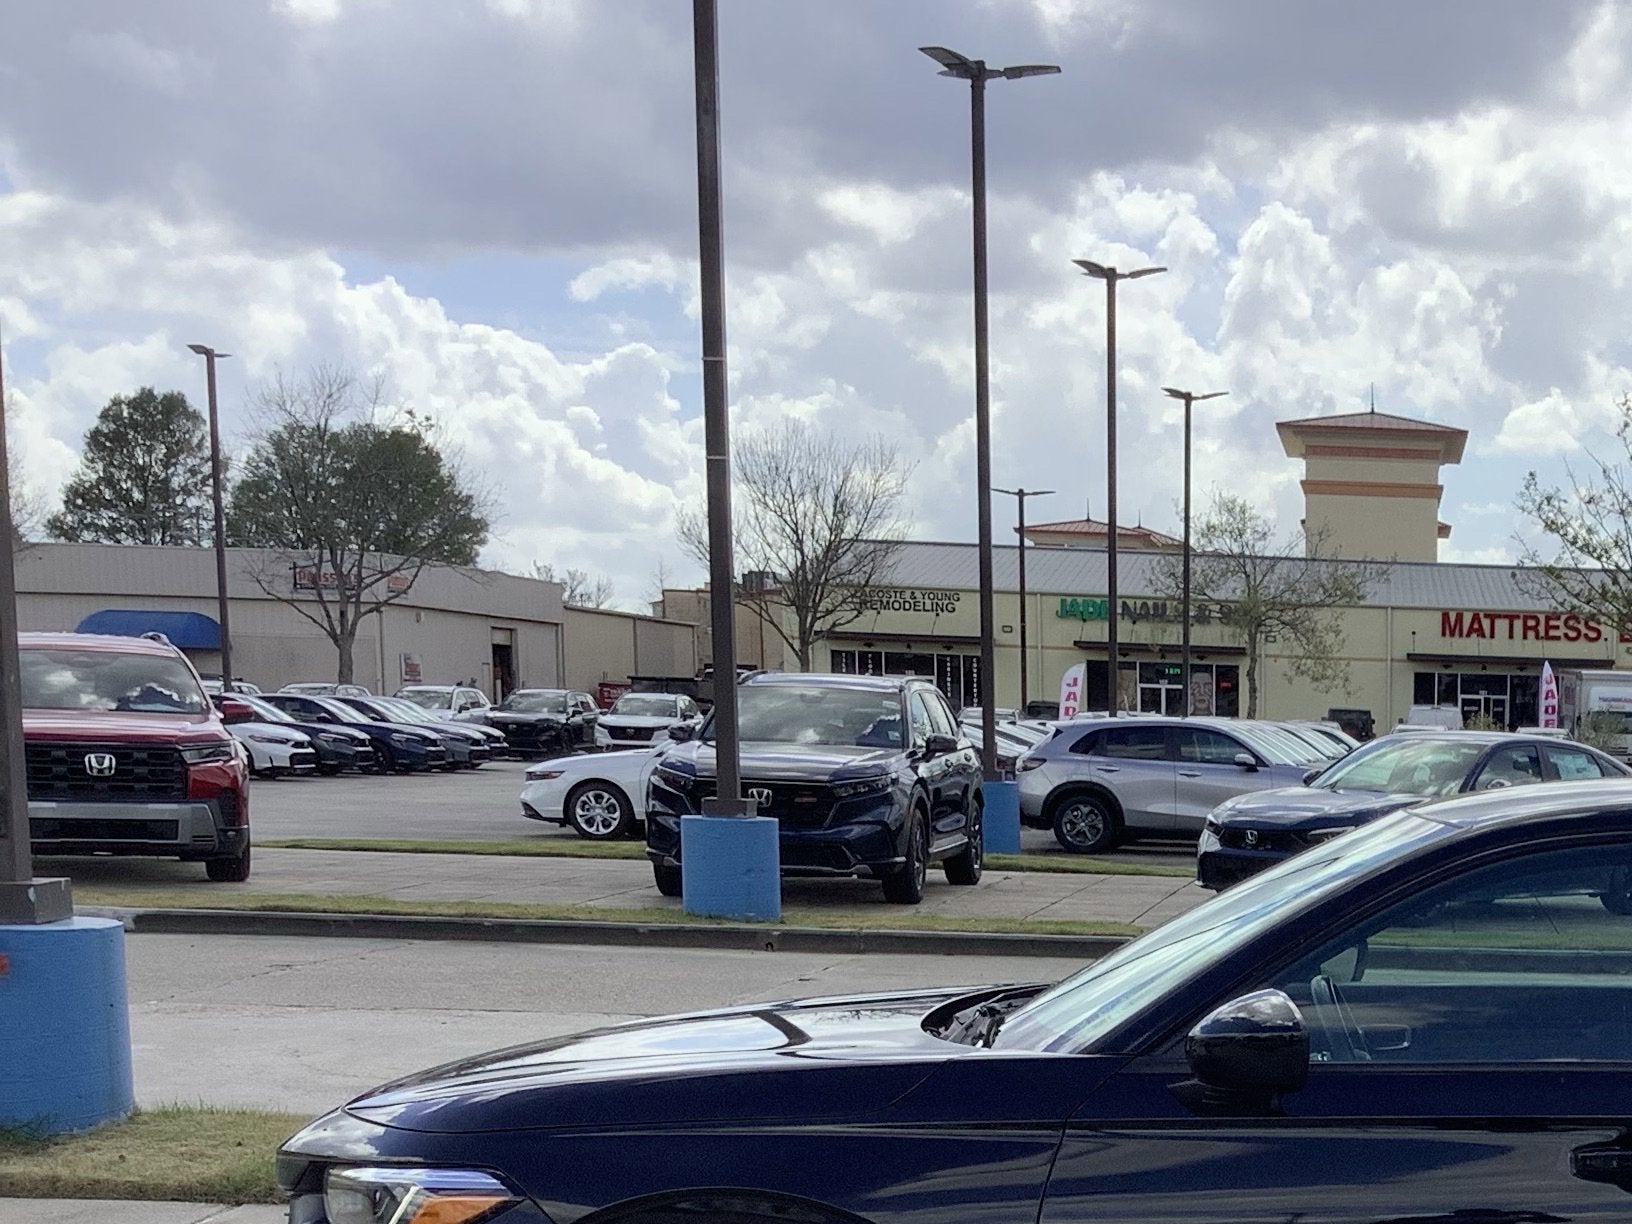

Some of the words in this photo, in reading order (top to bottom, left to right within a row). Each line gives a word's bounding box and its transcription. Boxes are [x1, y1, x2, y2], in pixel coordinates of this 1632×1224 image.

[910, 590, 917, 600] &
[920, 591, 961, 603] YOUNG
[858, 600, 956, 613] REMODELING
[1441, 611, 1602, 643] MATTRESS
